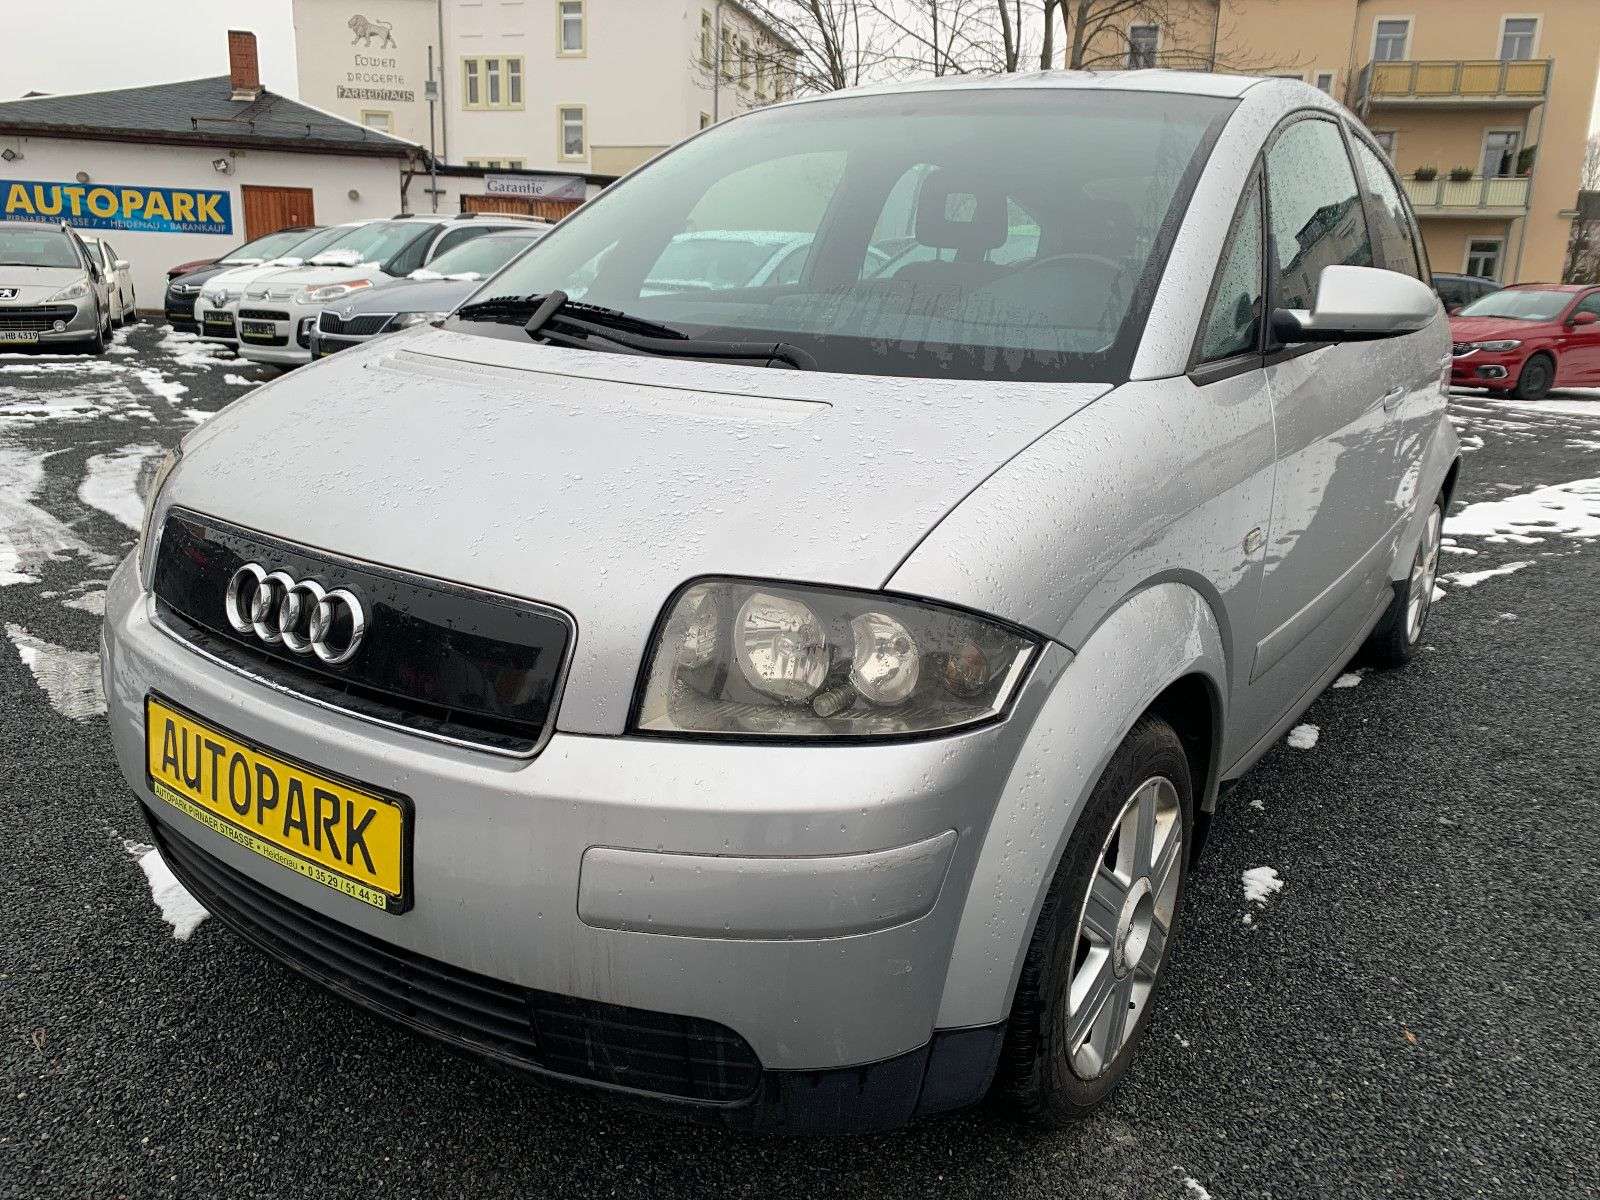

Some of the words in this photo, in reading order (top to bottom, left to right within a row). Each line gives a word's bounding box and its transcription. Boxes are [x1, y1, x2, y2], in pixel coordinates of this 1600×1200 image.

[5, 183, 225, 223] AUTOPARK
[487, 180, 544, 195] Garantie
[110, 219, 160, 230] HEIDENAU
[161, 717, 378, 876] AUTOPARK
[155, 784, 188, 811] AUTOPARK
[188, 807, 219, 831] PIRNAER
[219, 823, 255, 849] STRASSE
[262, 845, 298, 870] Heidenau
[315, 870, 326, 882] 35
[327, 874, 339, 888] 29
[345, 883, 356, 896] 51
[359, 889, 371, 902] 44
[373, 893, 385, 907] 33
